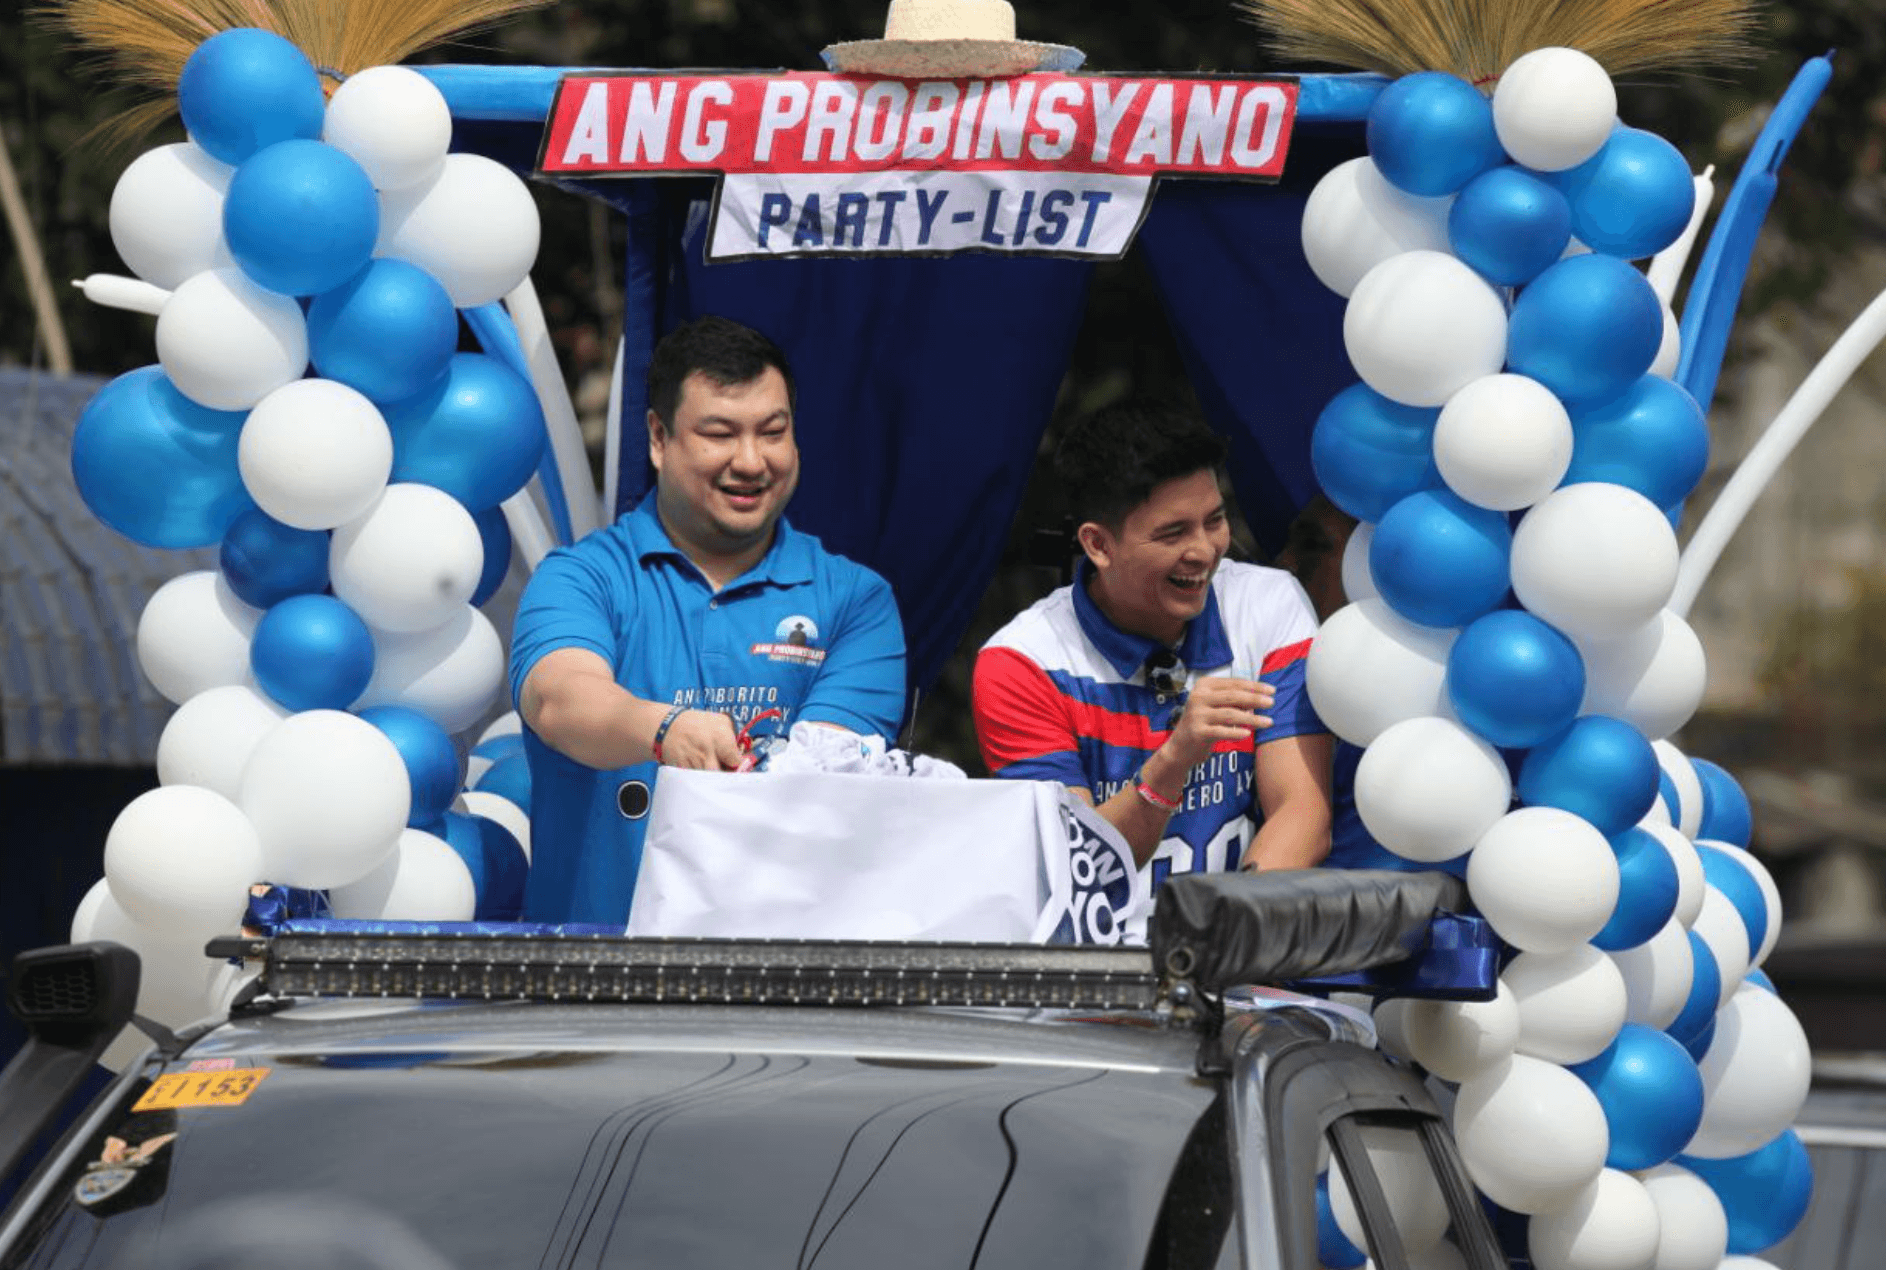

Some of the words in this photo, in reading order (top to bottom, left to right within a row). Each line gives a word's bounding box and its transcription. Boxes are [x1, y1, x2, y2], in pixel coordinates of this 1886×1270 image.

[562, 80, 734, 165] ANG
[753, 79, 1290, 168] PROBINSYANO
[756, 188, 1113, 250] PARTY-LIST
